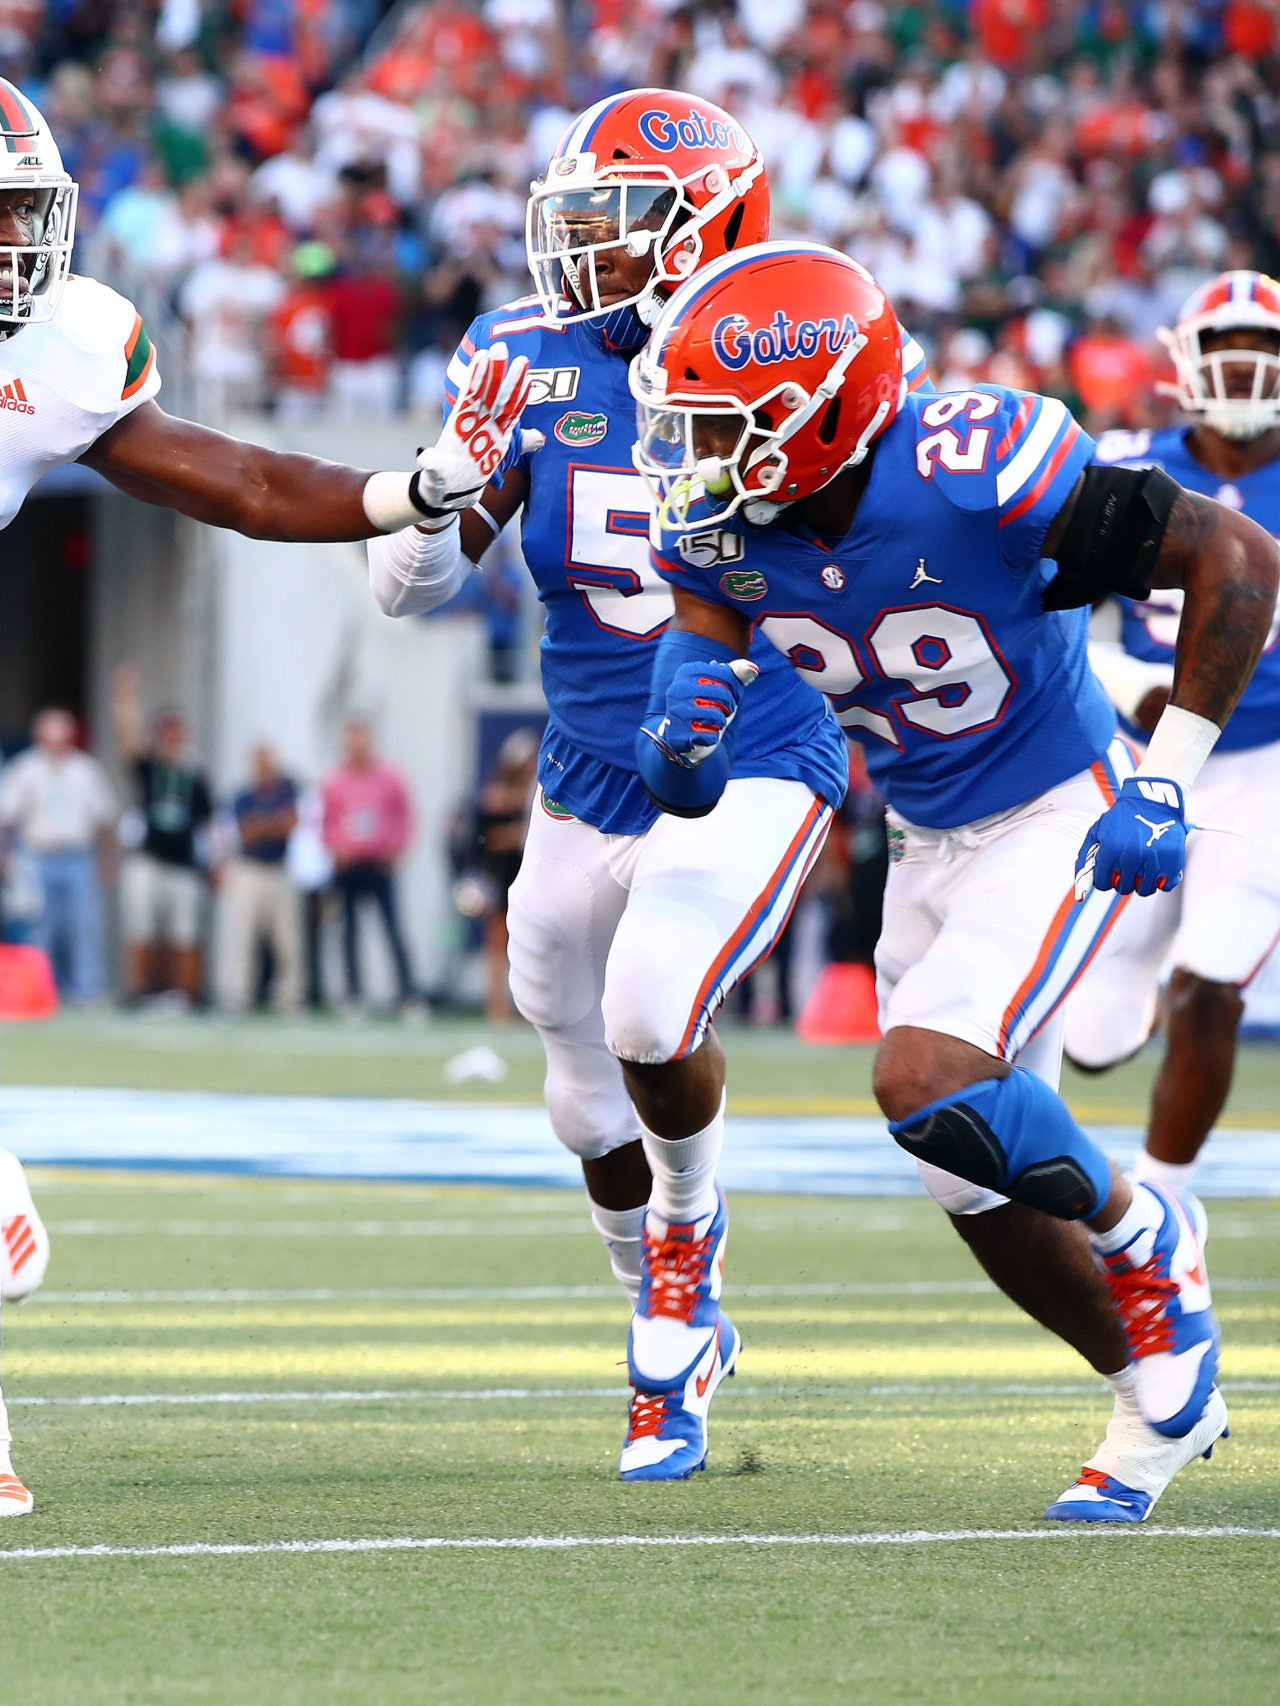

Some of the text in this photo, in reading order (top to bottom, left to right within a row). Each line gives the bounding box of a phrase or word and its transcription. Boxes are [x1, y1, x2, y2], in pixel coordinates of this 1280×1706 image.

[638, 110, 746, 152] Gator
[712, 310, 860, 371] Gators
[523, 369, 579, 401] 50
[916, 391, 1003, 482] 29
[680, 529, 744, 567] 150
[750, 601, 1018, 753] 29
